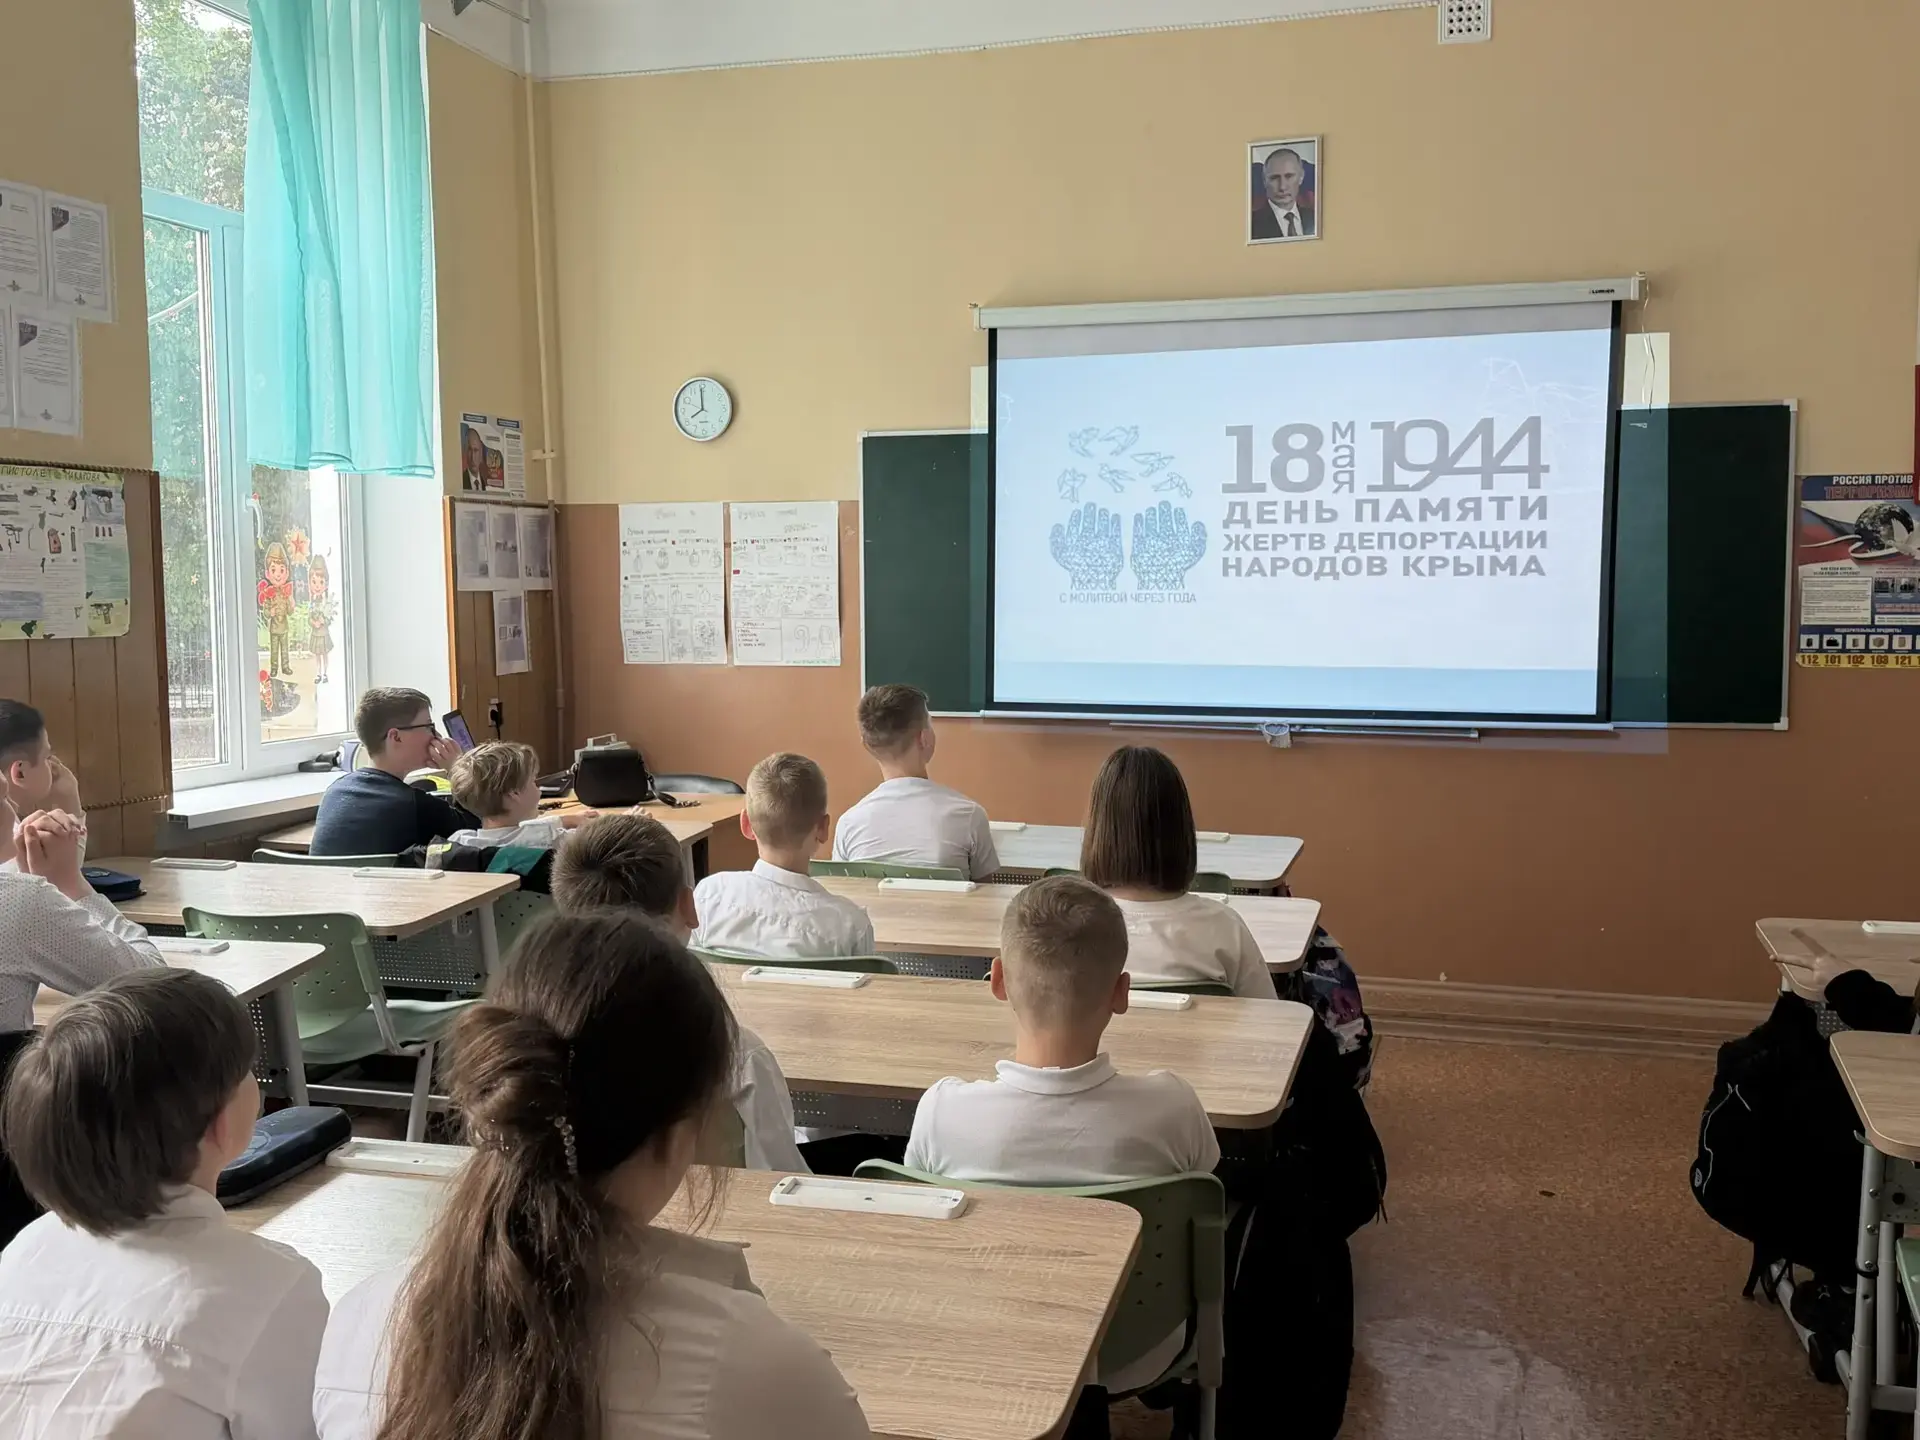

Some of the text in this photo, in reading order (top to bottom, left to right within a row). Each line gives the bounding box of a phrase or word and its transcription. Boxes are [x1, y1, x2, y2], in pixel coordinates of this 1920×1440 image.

[1222, 423, 1325, 494] 18
[1367, 416, 1550, 492] 1944
[1, 466, 53, 478] ПИСТОЛЕТ
[1833, 475, 1914, 485] РОССИЯ ПРОТИВ
[1222, 496, 1547, 529] ДЕНЬ ПАМЯТИ
[1223, 530, 1547, 553] ЖЕРТВ ДЕПОРТАЦИИ
[1222, 555, 1546, 581] НАРОДОВ КРЫМА
[1059, 592, 1197, 604] С МОЛИТВОЙ ЧЕРЕЗ ГОДА
[1801, 655, 1912, 665] 112 101 102 103 121
